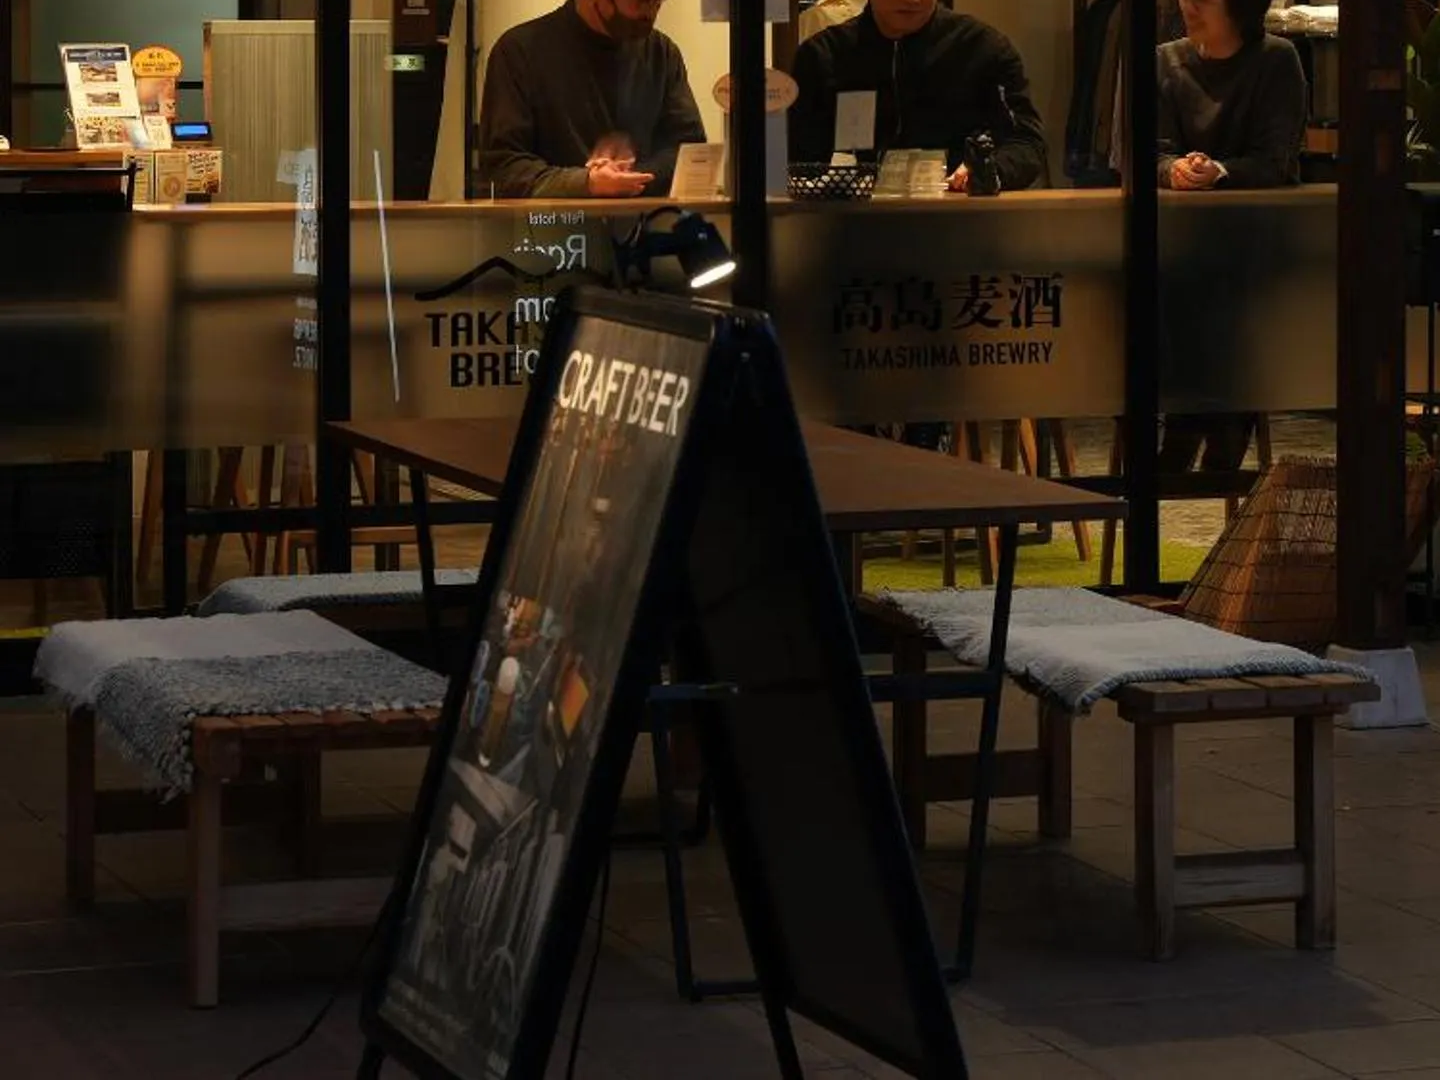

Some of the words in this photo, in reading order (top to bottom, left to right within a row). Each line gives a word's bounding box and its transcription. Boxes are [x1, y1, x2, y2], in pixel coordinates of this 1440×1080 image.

[834, 273, 1064, 333] 高島麦酒
[839, 344, 962, 372] TAKASHIMA
[968, 341, 1055, 367] BREWRY
[558, 349, 636, 421] CRAFT
[626, 366, 690, 437] BEER
